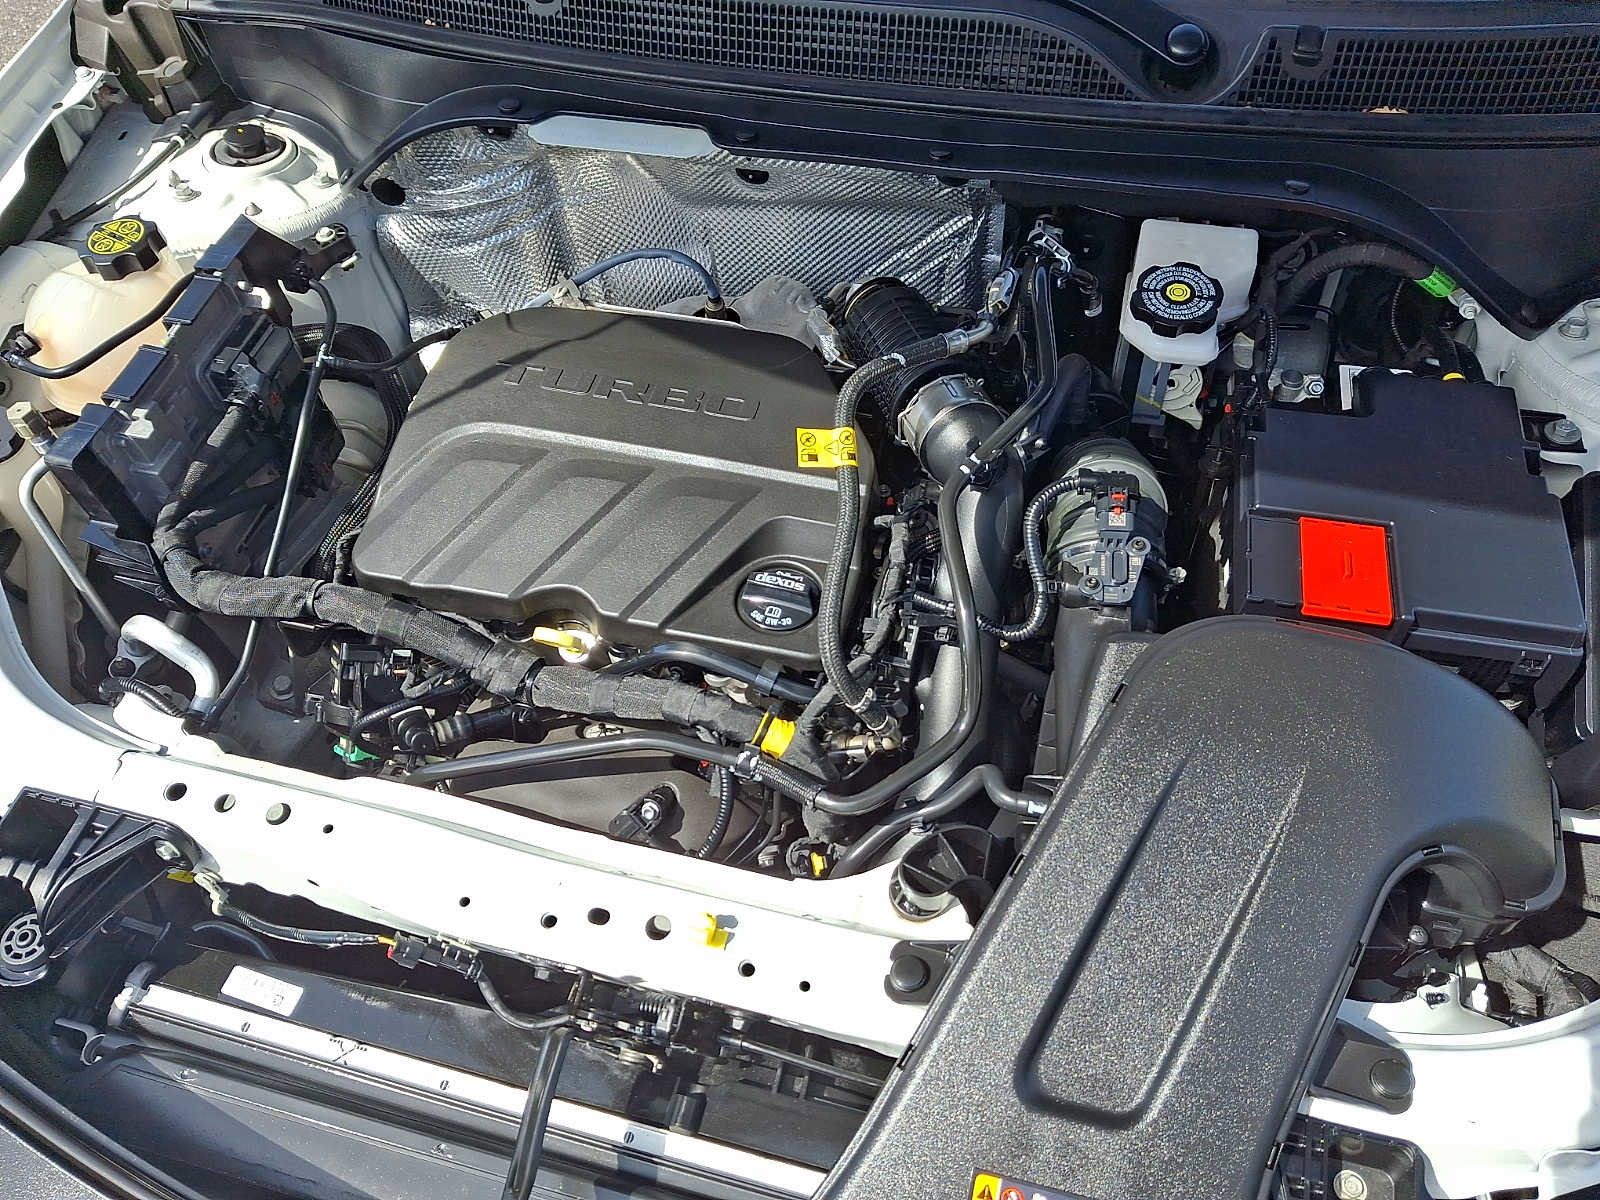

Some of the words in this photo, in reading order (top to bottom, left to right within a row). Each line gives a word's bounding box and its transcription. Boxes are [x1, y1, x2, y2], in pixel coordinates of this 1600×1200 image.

[496, 360, 760, 422] TURBO
[755, 572, 806, 591] dexos
[765, 617, 792, 626] 5W-30
